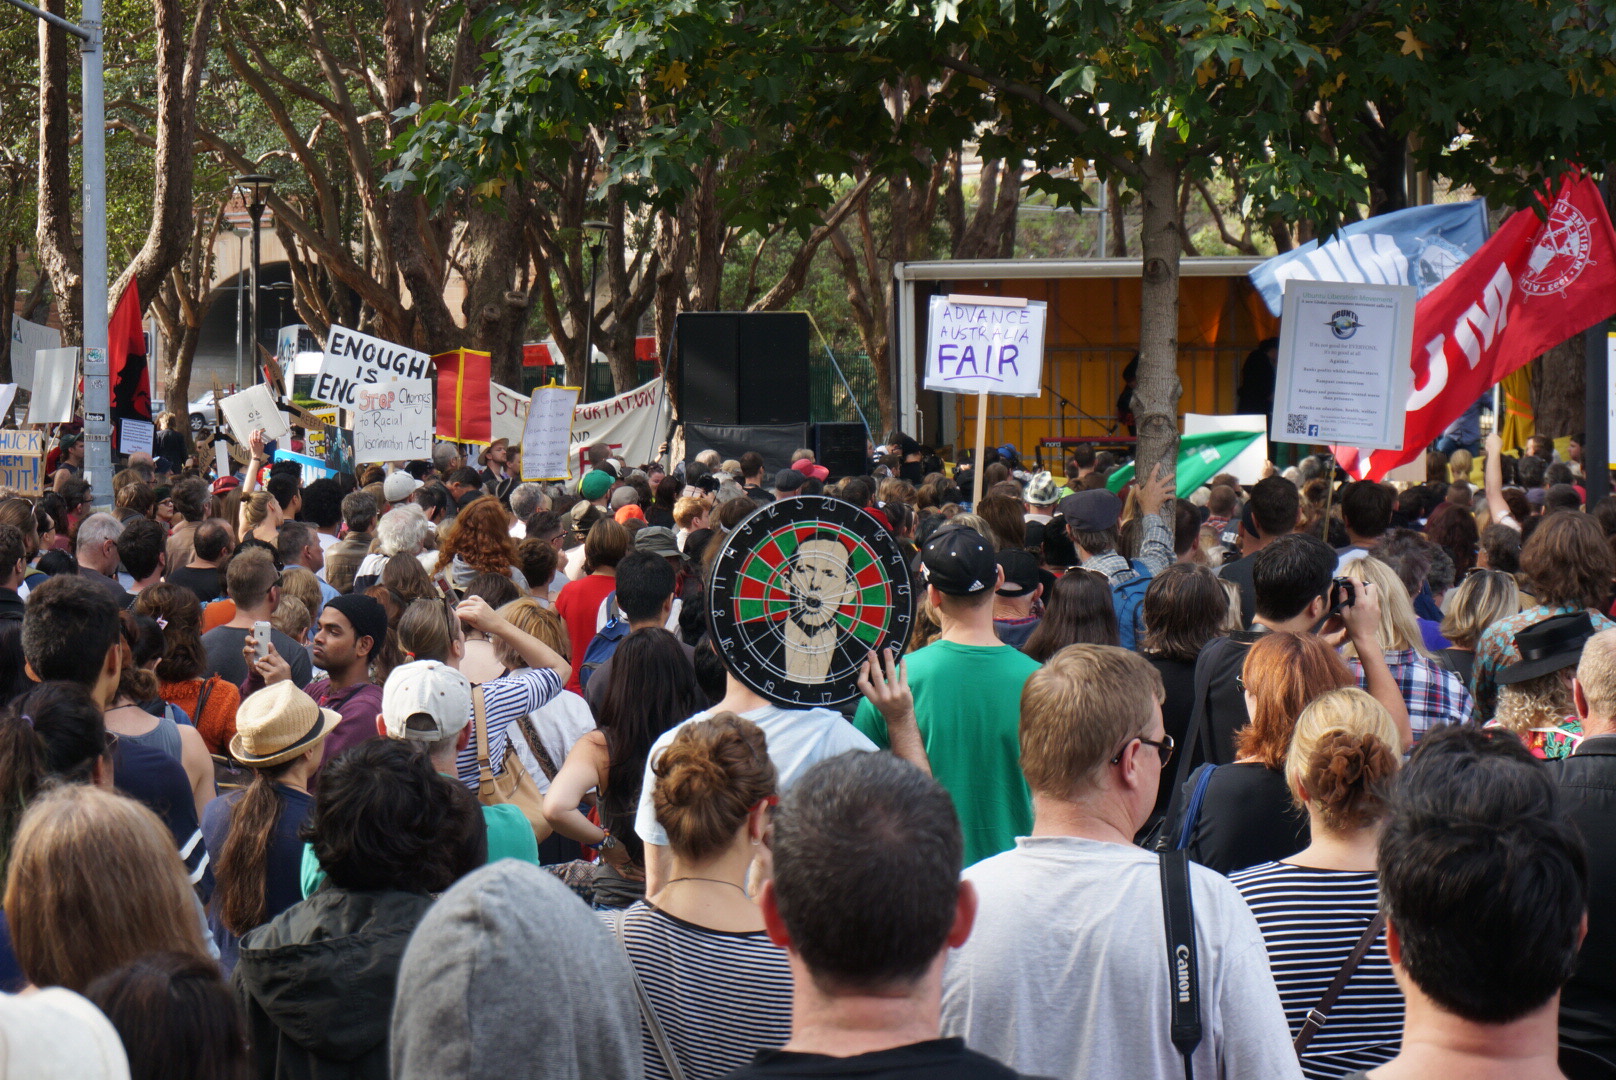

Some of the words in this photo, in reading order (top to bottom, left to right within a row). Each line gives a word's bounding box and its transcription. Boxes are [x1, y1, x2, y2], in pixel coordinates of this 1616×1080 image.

[1302, 291, 1326, 300] Ubuntu
[1327, 293, 1358, 301] Liberation
[1359, 295, 1393, 303] Movement
[943, 306, 1030, 325] ADVANCE
[940, 325, 1030, 345] AUSTRALIA
[330, 332, 426, 380] ENOUGH
[938, 344, 1019, 376] FAIR
[356, 365, 378, 384] IS
[358, 389, 396, 411] STOP
[398, 388, 432, 415] Changes
[573, 387, 657, 422] PORTATION
[359, 415, 370, 427] to
[372, 412, 404, 432] Racial
[796, 498, 804, 510] 5
[821, 497, 837, 512] 20
[767, 505, 780, 519] 12
[742, 522, 753, 535] 9
[873, 530, 887, 542] 18
[722, 546, 738, 559] 14
[891, 554, 903, 566] 4
[713, 576, 727, 589] 11
[898, 583, 911, 595] 13
[712, 609, 726, 619] 8
[897, 614, 911, 624] 6
[720, 636, 735, 651] 16
[889, 640, 903, 656] 10
[740, 662, 751, 674] 7
[762, 679, 776, 694] 19
[848, 684, 858, 697] 2
[792, 690, 801, 703] 3
[819, 691, 833, 706] 17
[1176, 944, 1191, 1003] Canon
